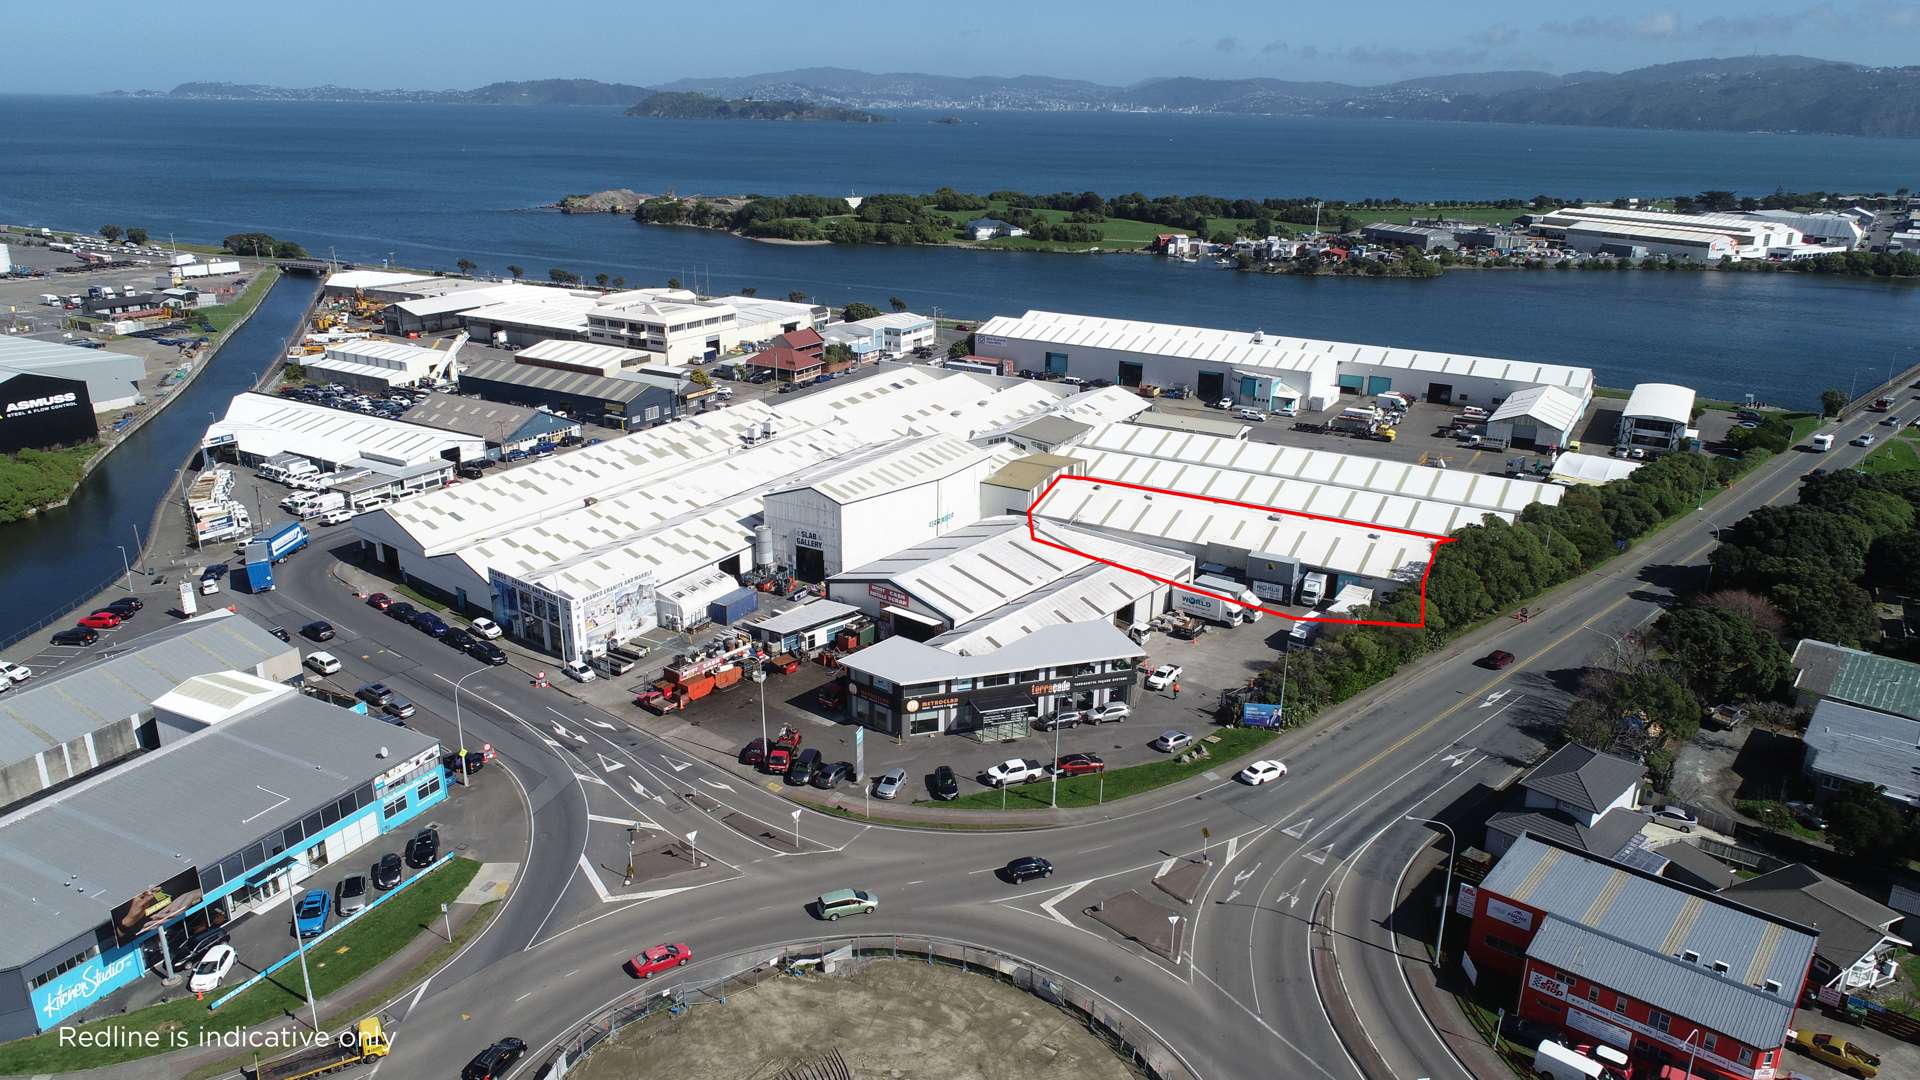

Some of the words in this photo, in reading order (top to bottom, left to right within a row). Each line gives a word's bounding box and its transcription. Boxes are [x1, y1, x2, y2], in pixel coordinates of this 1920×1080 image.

[6, 392, 76, 413] ASMUSS
[50, 402, 78, 410] CONTROL
[801, 530, 817, 540] SLAB
[796, 537, 823, 549] GALLERY
[603, 582, 624, 595] GRANITE
[624, 578, 634, 586] AND
[634, 569, 653, 582] MARBLE
[1182, 596, 1212, 608] WORLD
[1540, 981, 1563, 997] Stop
[1545, 979, 1561, 990] Pit
